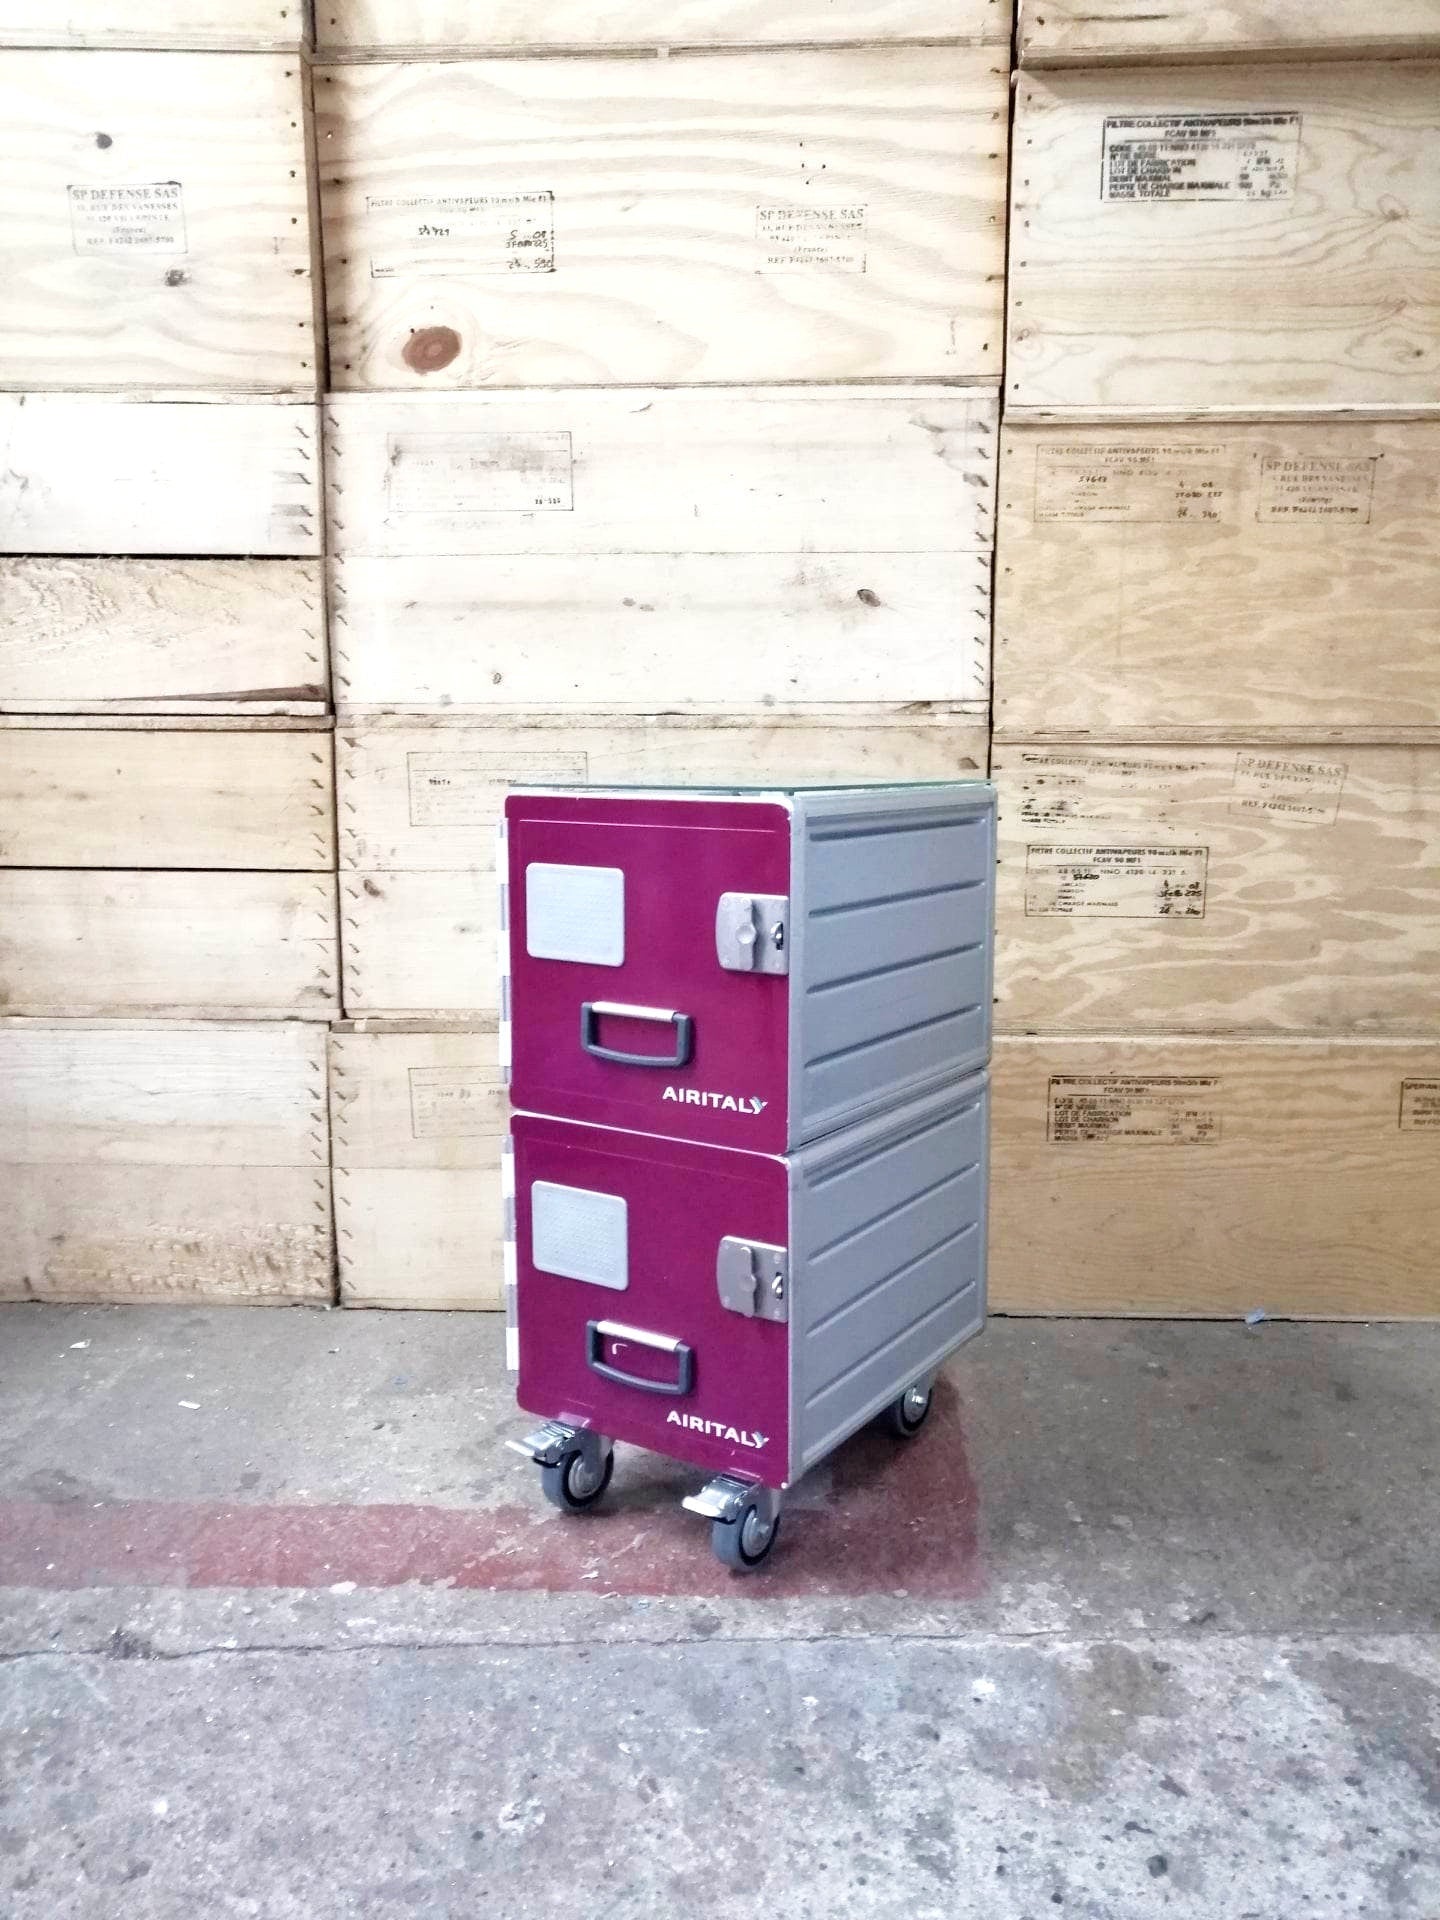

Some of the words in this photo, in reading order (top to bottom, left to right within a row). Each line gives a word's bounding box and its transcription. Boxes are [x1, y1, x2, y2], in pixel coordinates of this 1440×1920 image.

[90, 187, 153, 200] DEFENSE
[154, 186, 178, 199] SAS
[1257, 759, 1314, 774] DEFENSE
[1055, 847, 1094, 856] COLLECTIF
[662, 1086, 768, 1115] AIRITALY
[1082, 1110, 1132, 1118] FABRICATION
[666, 1410, 770, 1449] AIRITALY
